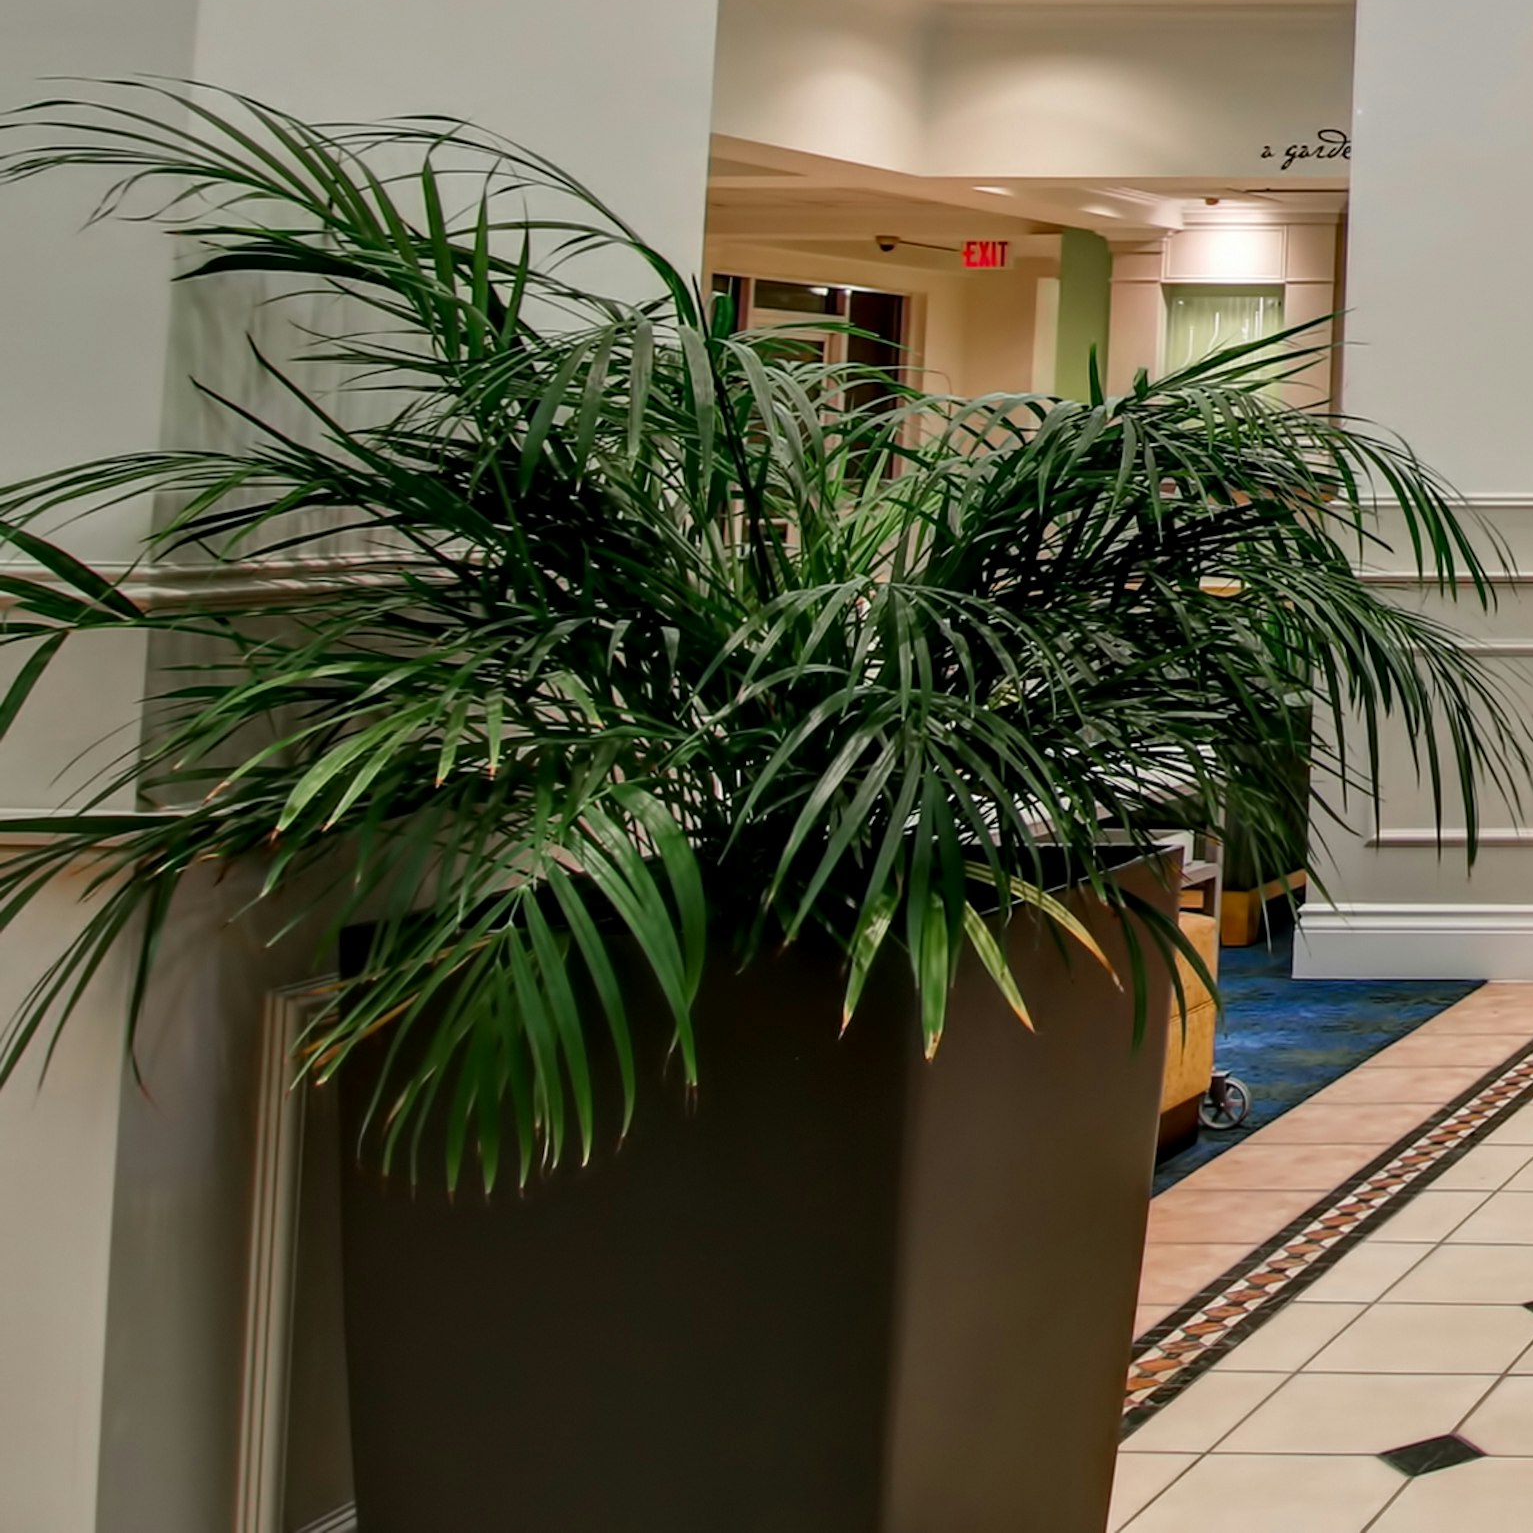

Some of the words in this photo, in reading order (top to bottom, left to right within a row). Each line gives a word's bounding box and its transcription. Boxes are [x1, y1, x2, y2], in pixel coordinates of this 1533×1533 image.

[1260, 145, 1274, 159] a
[1280, 129, 1351, 171] garde
[966, 241, 1008, 267] EXIT
